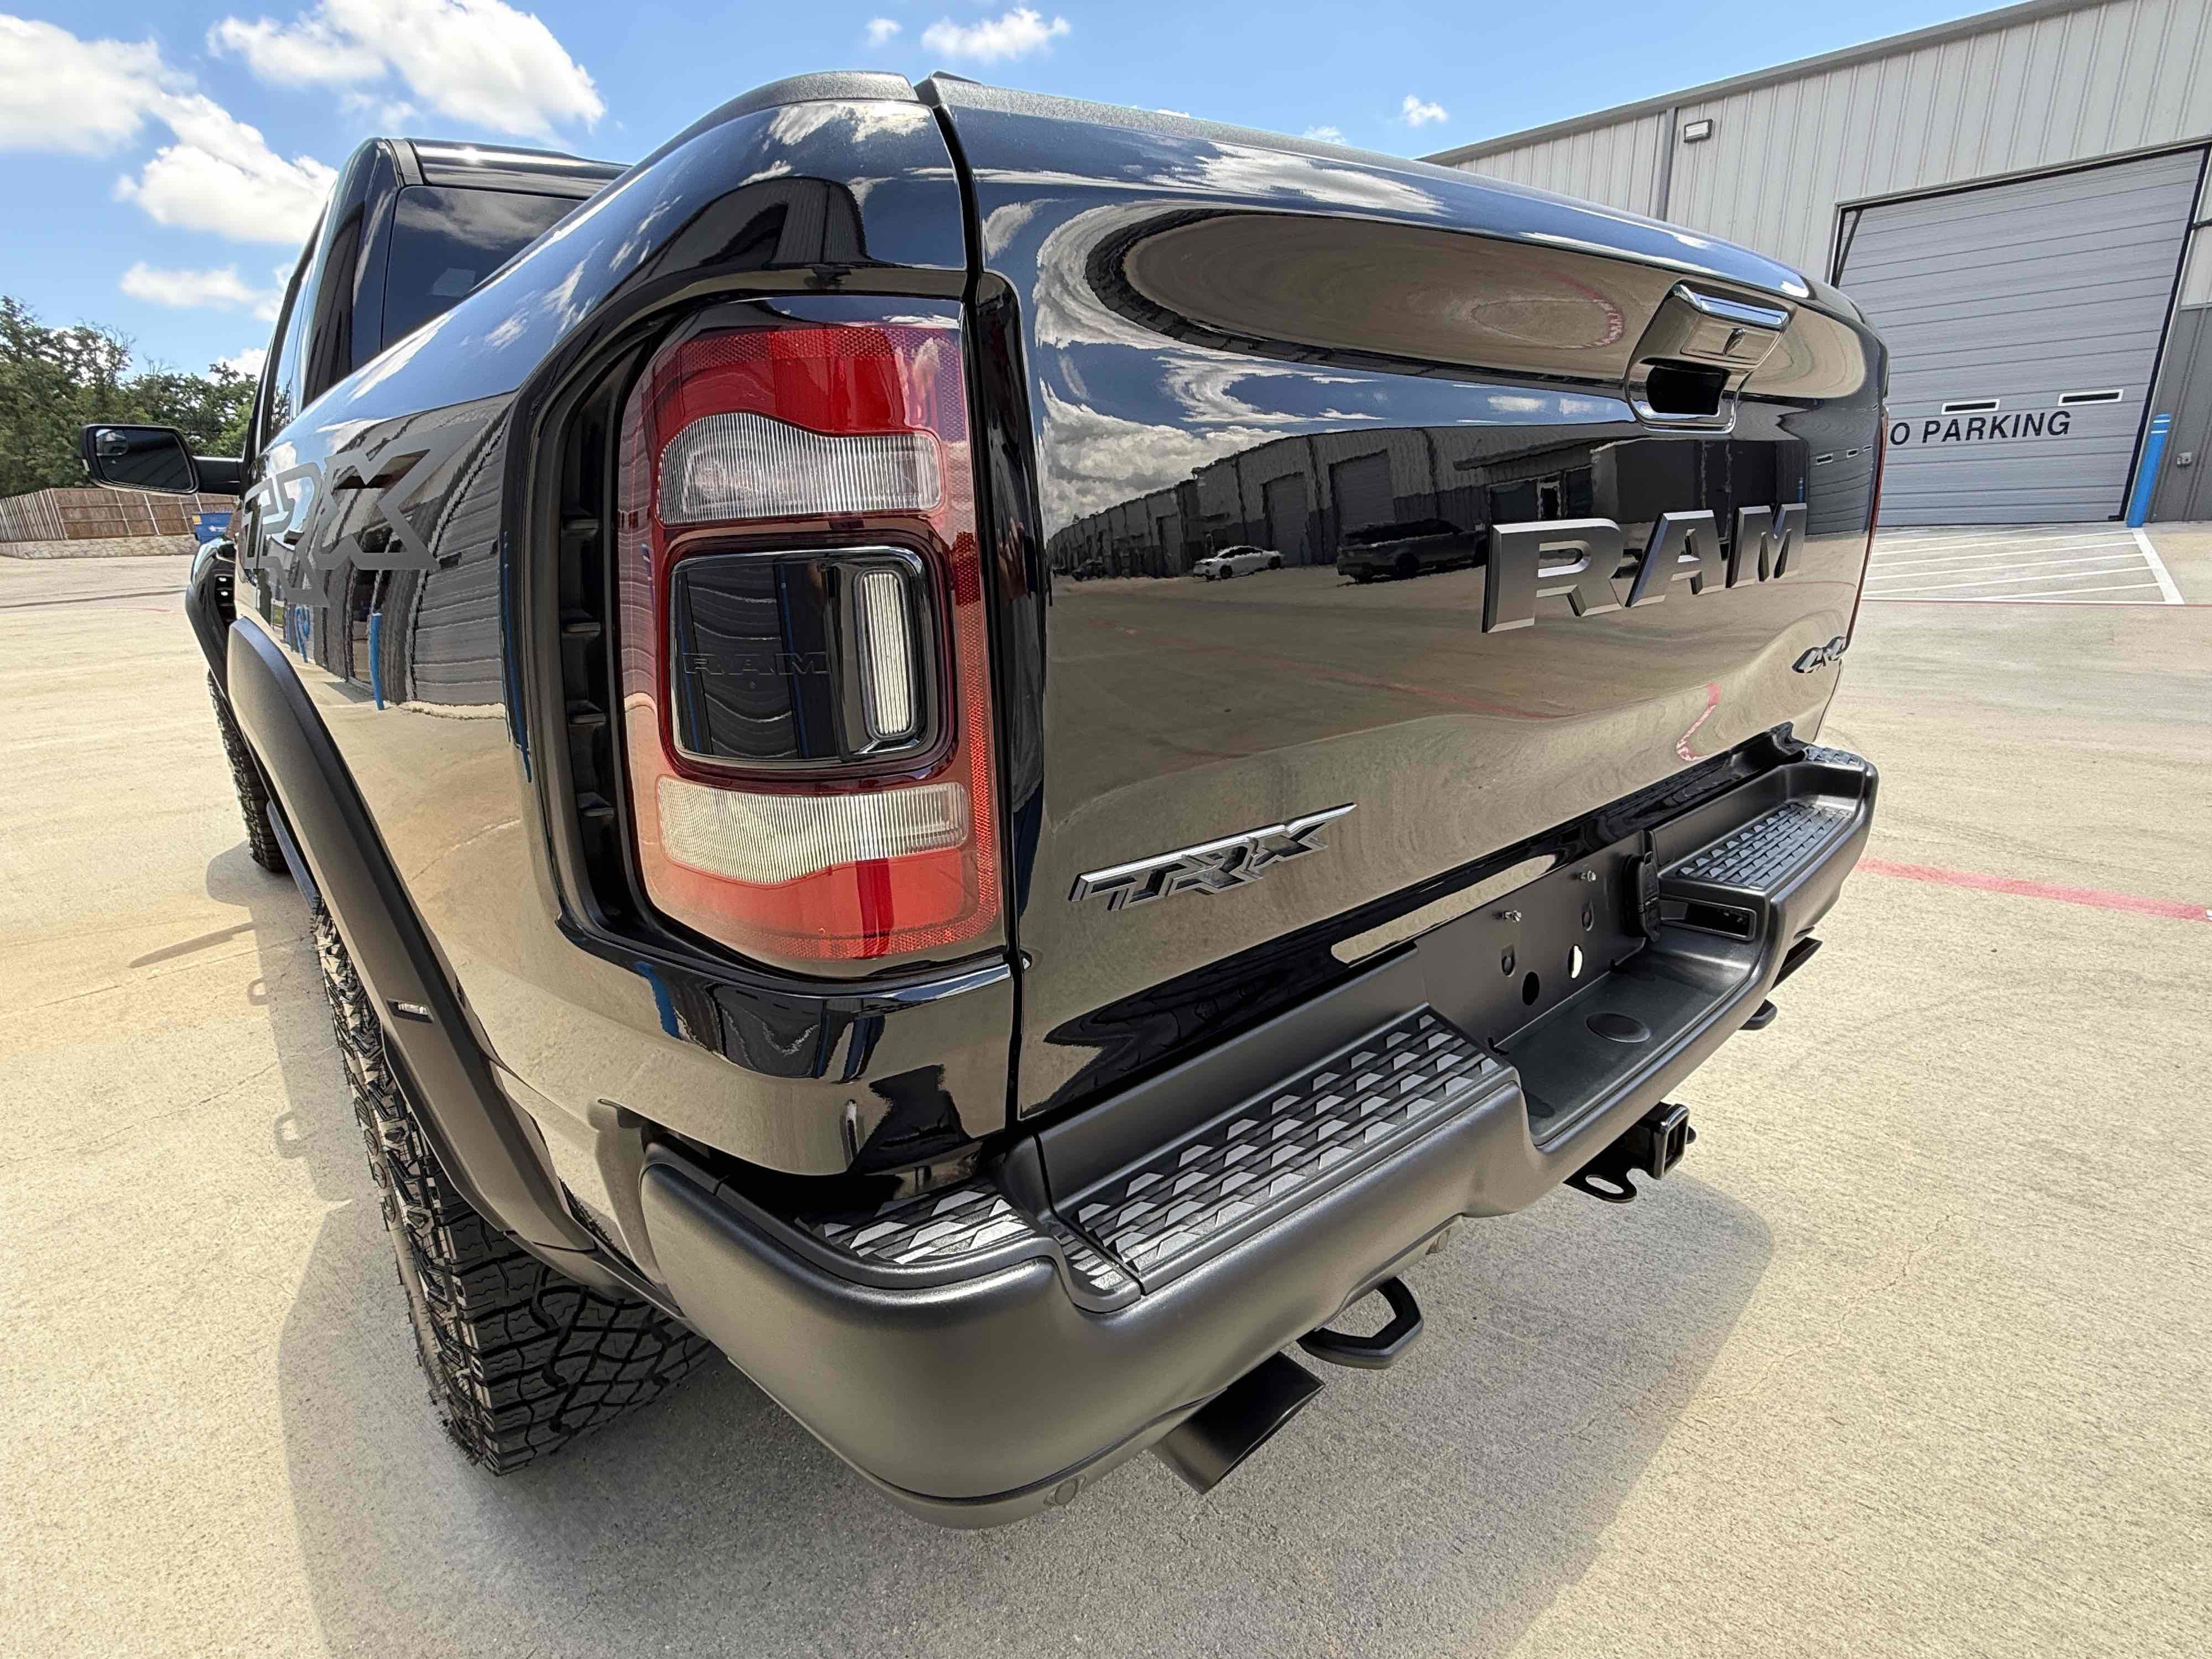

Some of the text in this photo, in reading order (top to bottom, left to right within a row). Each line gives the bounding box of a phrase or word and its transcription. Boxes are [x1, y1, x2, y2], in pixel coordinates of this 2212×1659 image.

[1889, 410, 2071, 446] O PARKING
[1482, 503, 1807, 633] RAM
[682, 651, 830, 675] RAM
[1068, 802, 1358, 911] TRX
